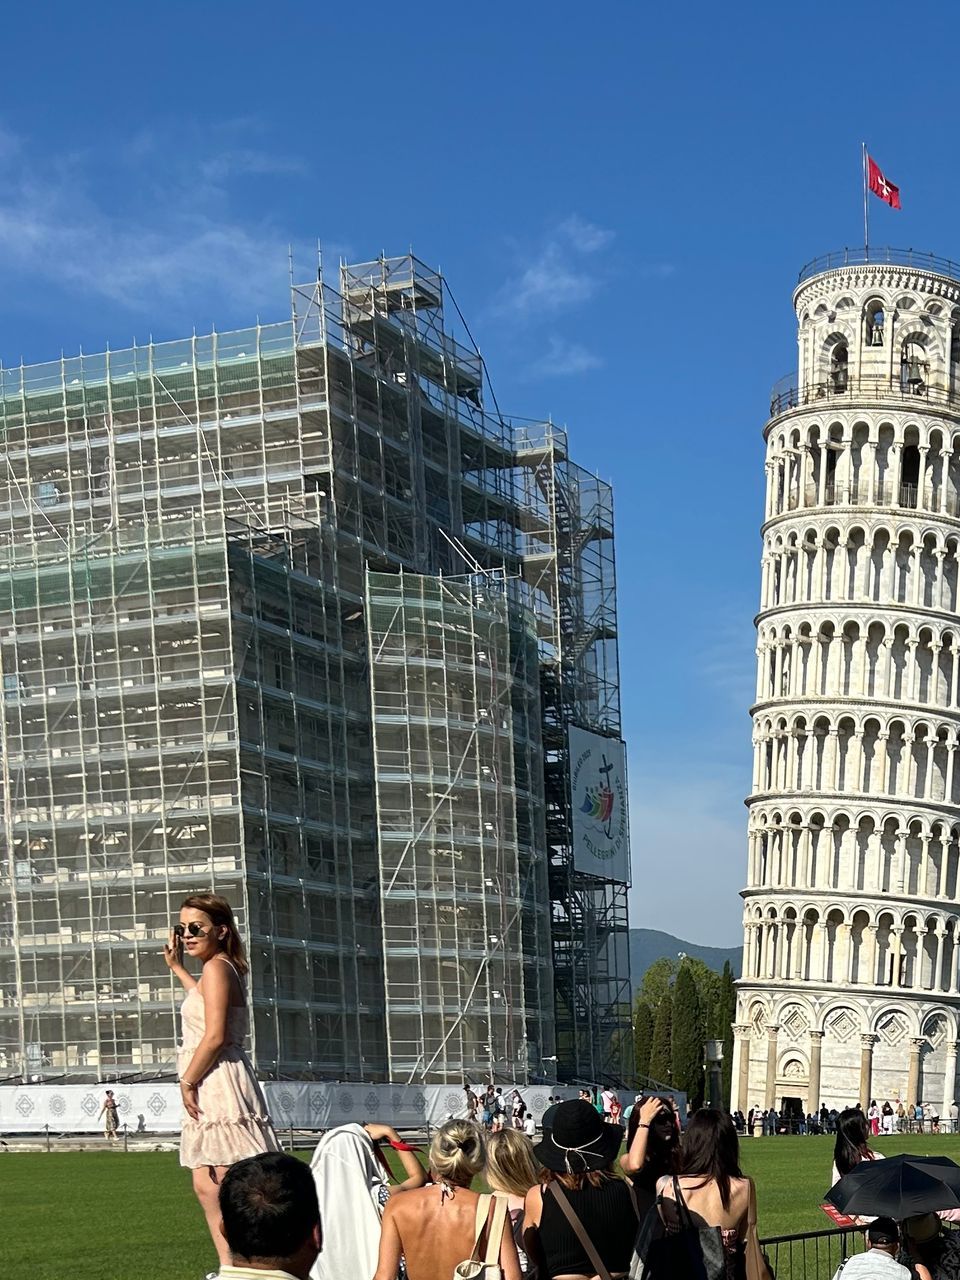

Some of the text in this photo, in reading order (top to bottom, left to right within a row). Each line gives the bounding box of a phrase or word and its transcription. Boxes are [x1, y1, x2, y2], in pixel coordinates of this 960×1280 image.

[582, 776, 626, 861] PELLEGRINI DI SPERANZA
